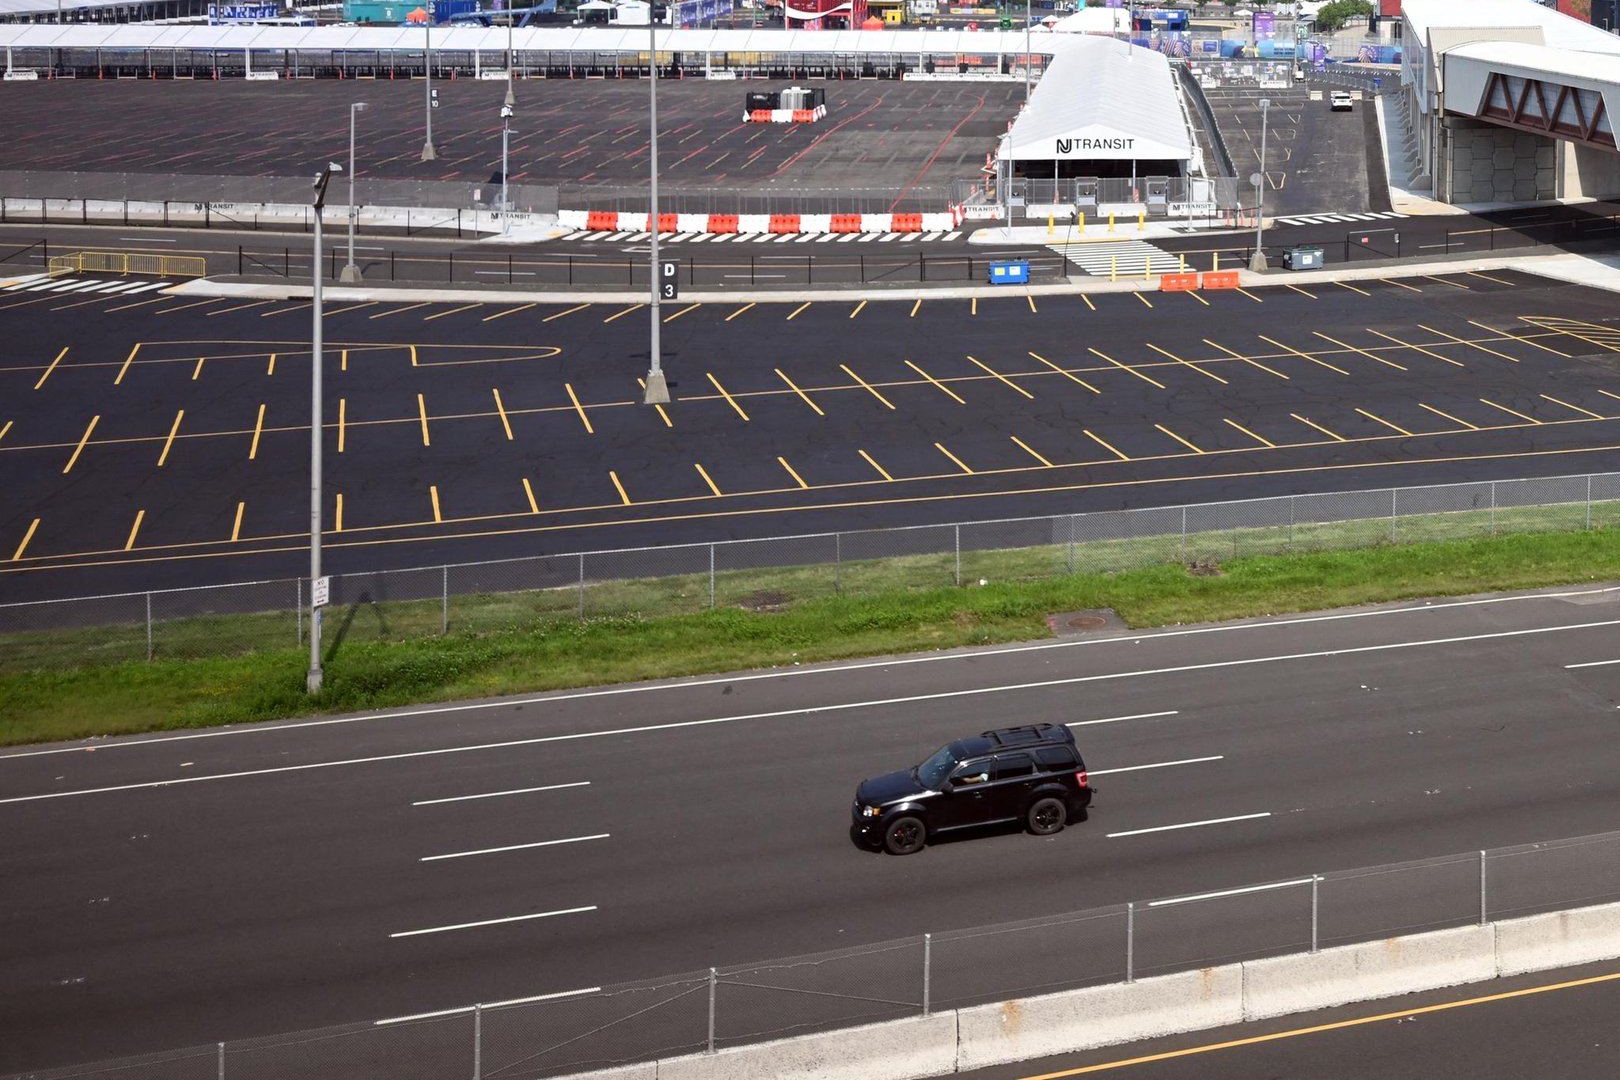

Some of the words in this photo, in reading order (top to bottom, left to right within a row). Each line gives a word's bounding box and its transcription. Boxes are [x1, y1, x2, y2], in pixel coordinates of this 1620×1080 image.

[1074, 138, 1135, 149] TRANSIT
[664, 263, 675, 277] D
[665, 284, 674, 297] 3
